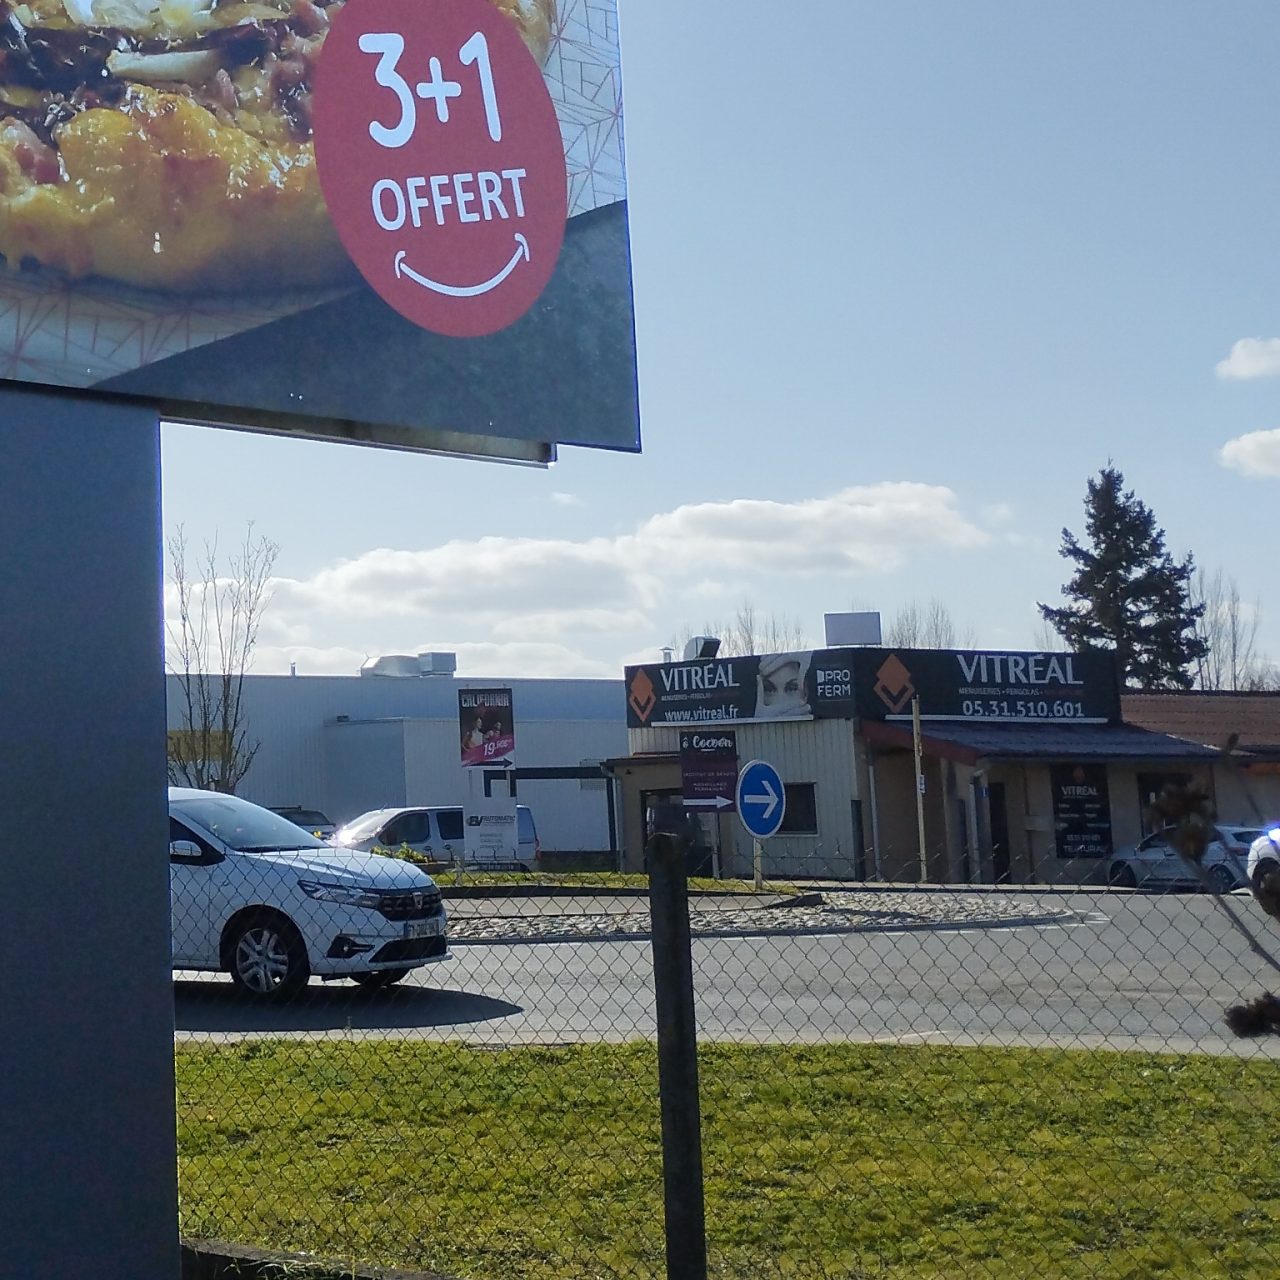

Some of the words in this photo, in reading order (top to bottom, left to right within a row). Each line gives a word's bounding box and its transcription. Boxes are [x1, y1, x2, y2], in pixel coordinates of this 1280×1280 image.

[358, 30, 503, 149] 3+1
[371, 167, 528, 233] OFFERT
[660, 663, 740, 692] VITRÉAL
[956, 653, 1084, 685] VITRÉAL
[817, 683, 851, 697] FERM
[665, 705, 739, 722] www.vitreal.fr
[962, 700, 1085, 718] 05.31.510.601
